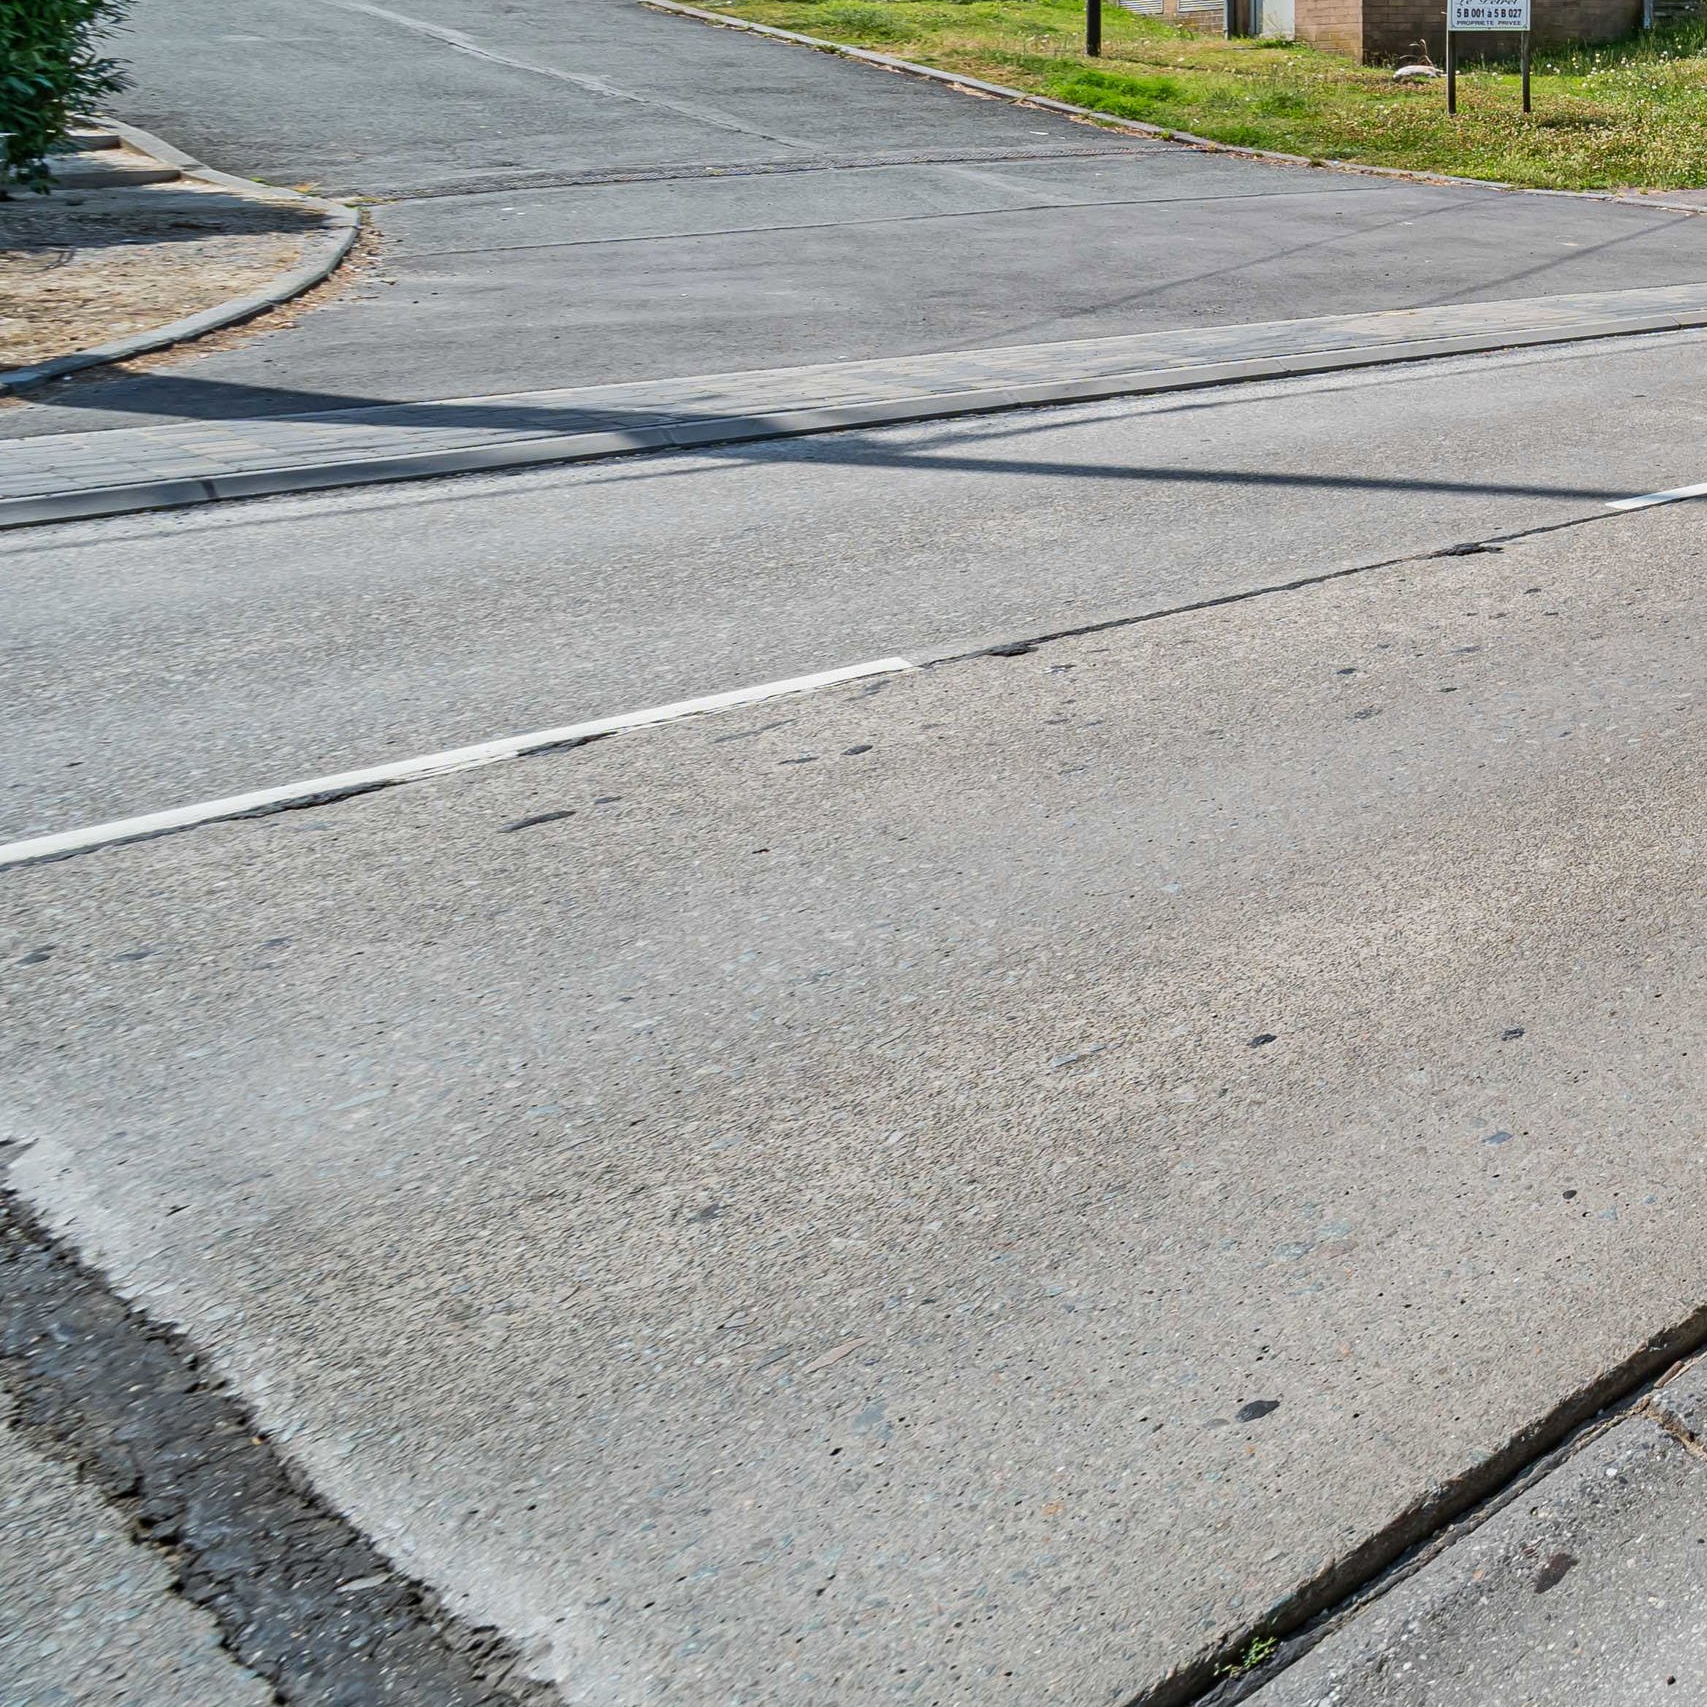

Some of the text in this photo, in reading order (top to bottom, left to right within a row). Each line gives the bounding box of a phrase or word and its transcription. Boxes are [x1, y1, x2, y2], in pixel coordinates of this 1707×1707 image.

[1457, 8, 1462, 18] 5
[1464, 8, 1469, 18] B
[1471, 8, 1484, 18] 001
[1494, 8, 1499, 18] 5
[1501, 8, 1506, 18] B
[1508, 8, 1522, 18] 027
